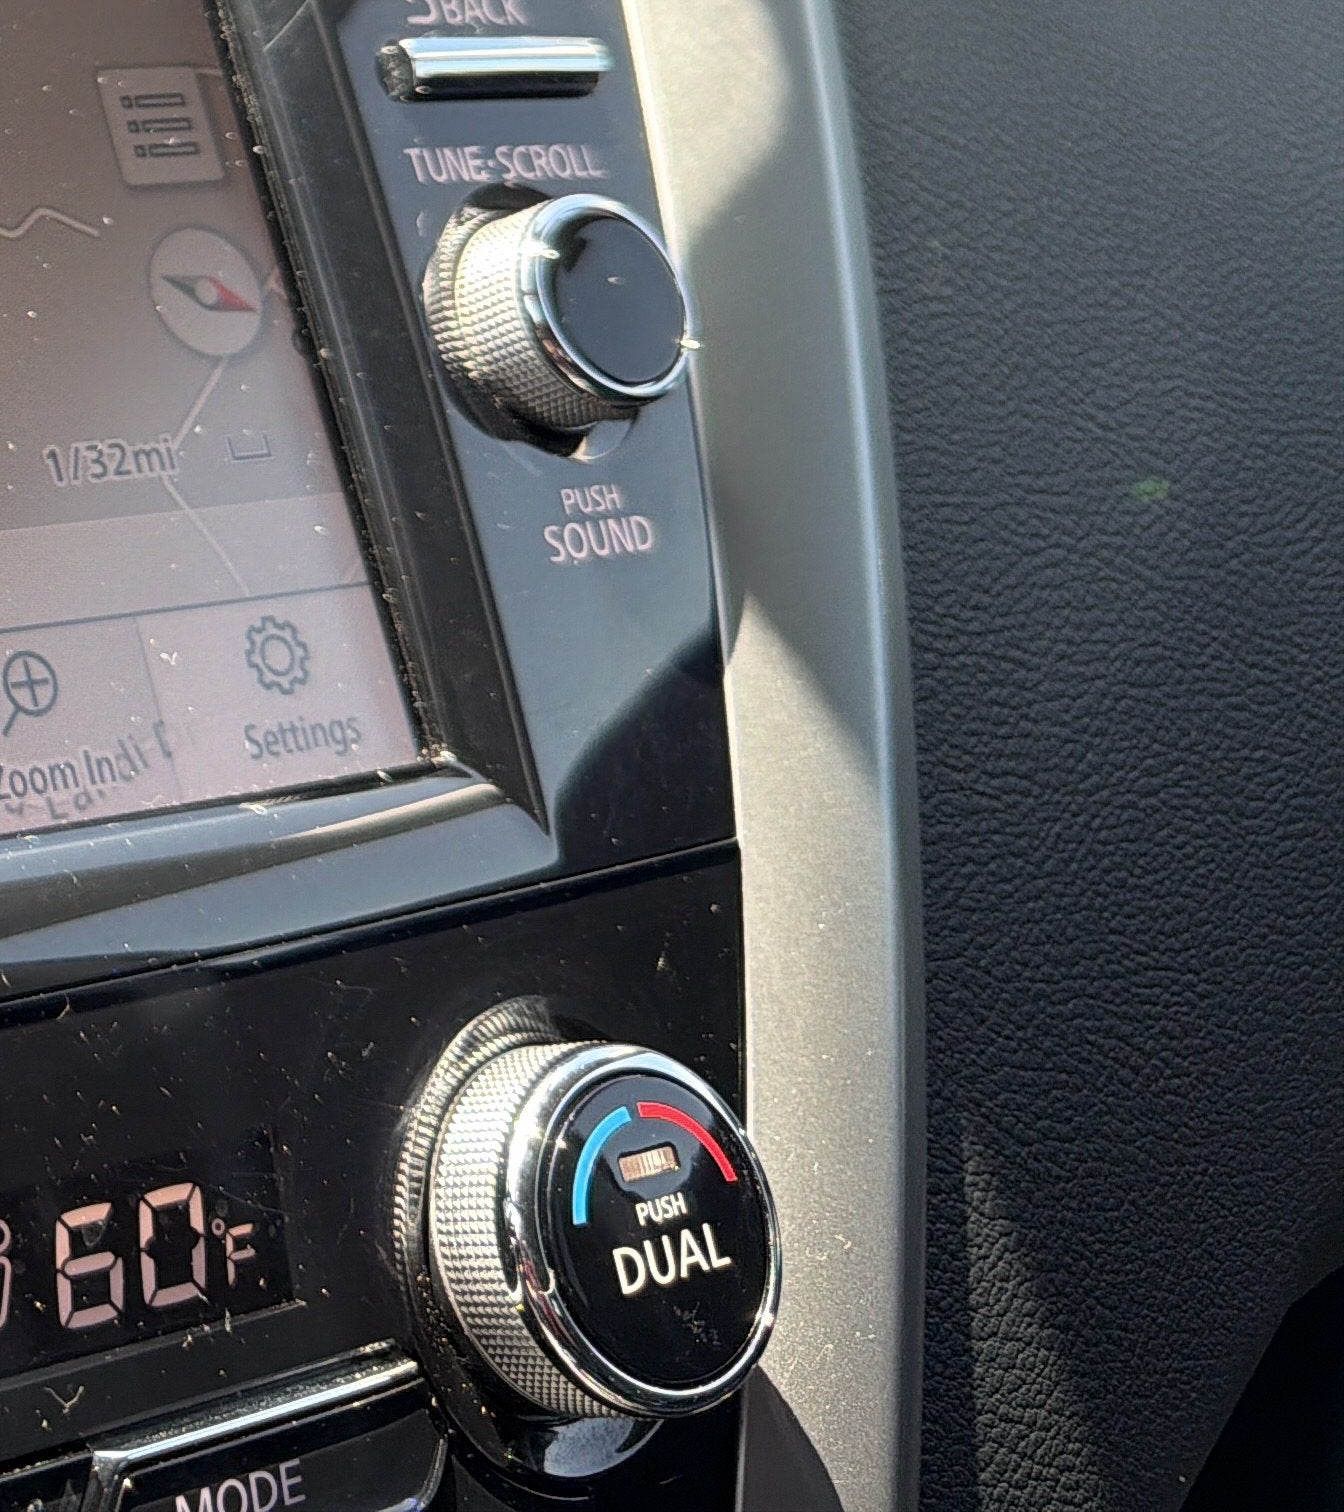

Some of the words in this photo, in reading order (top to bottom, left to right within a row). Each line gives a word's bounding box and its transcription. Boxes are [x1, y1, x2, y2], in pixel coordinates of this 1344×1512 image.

[562, 485, 620, 515] PUSH
[543, 518, 654, 565] SOUND
[244, 710, 362, 765] Settings
[635, 1192, 688, 1227] PUSH
[612, 1223, 732, 1295] DUAL
